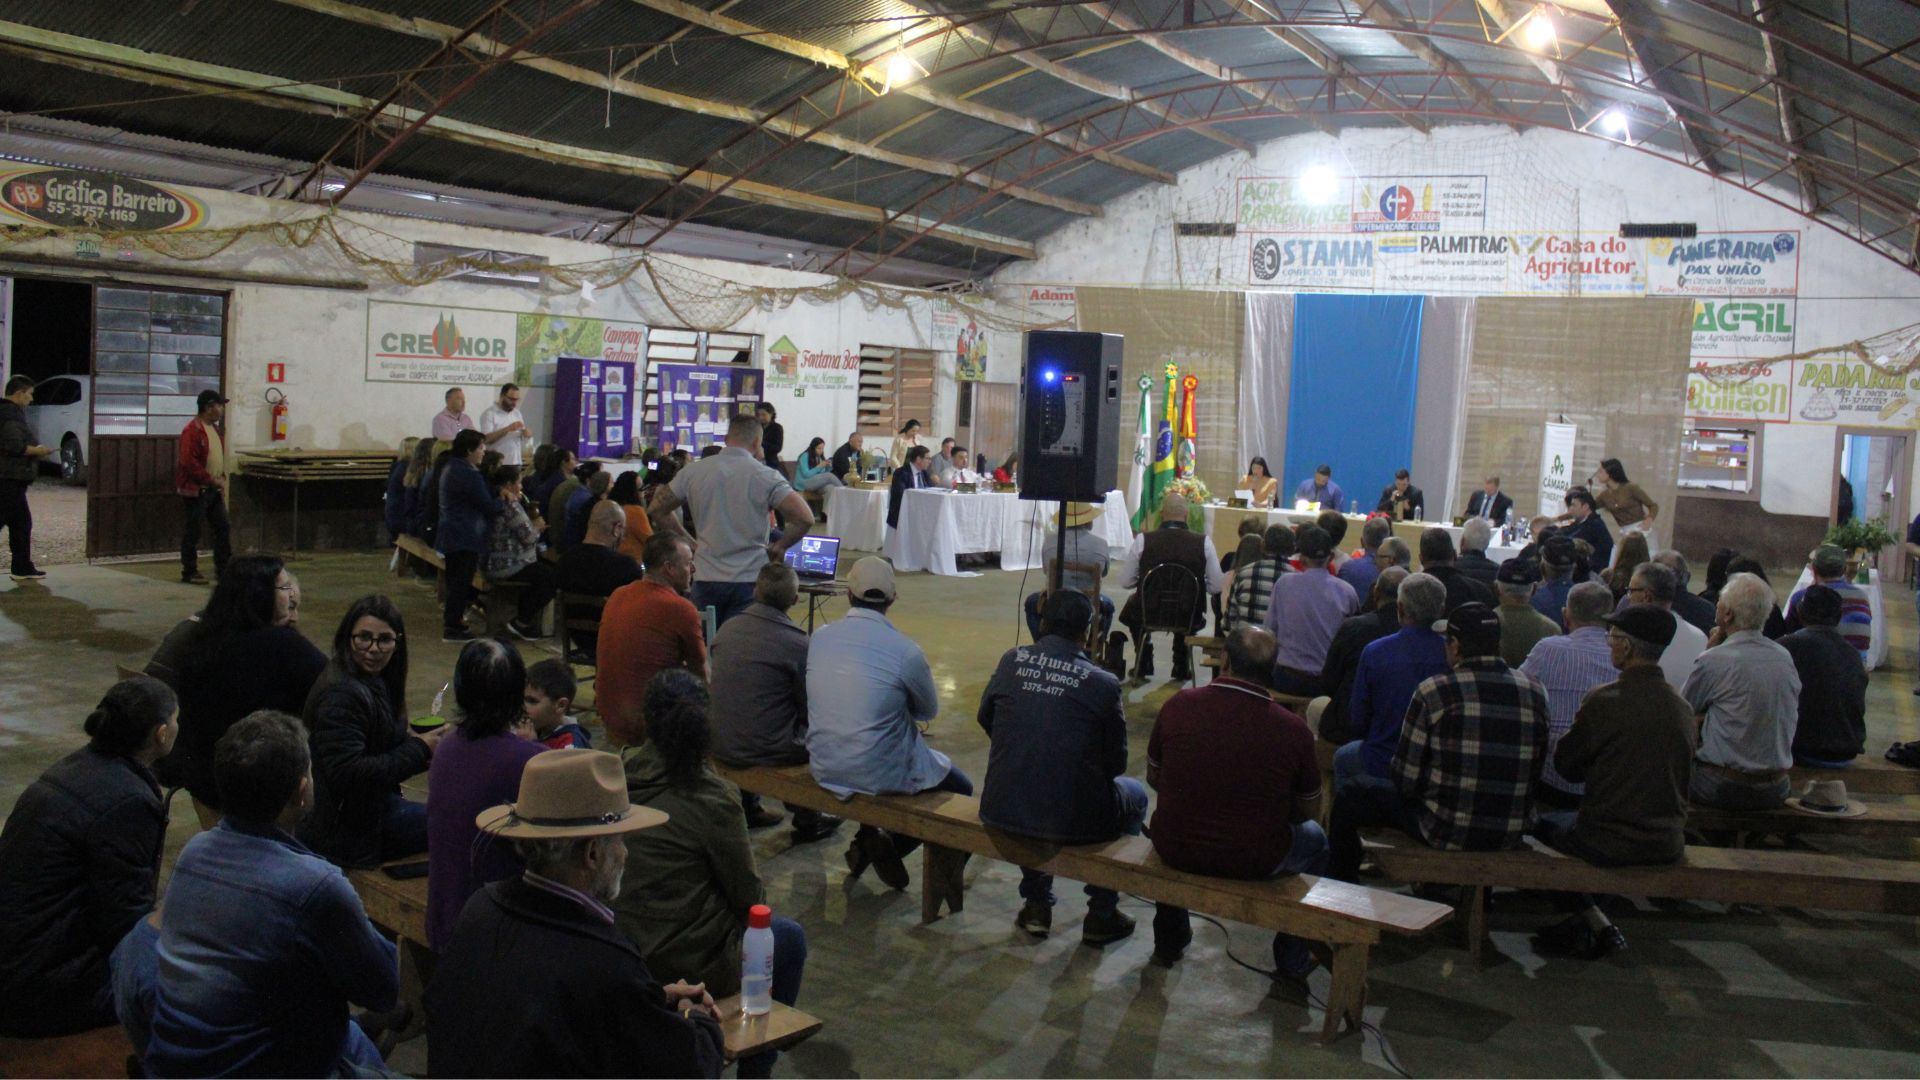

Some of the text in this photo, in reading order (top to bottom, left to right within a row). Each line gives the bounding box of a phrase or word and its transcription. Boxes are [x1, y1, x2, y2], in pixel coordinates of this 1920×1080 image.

[14, 185, 40, 204] GB
[45, 178, 177, 213] Gráfica Barreiro
[47, 201, 138, 222] 55-3757-1169
[1283, 239, 1373, 267] STAMM
[1421, 235, 1508, 254] PALMITRAC
[1545, 235, 1627, 254] Casa do
[1524, 255, 1636, 281] Agricultor
[1685, 261, 1762, 276] PAX UNIÃO
[603, 326, 643, 347] Camping
[801, 349, 841, 370] Fontana
[1798, 362, 1908, 391] PADARIA
[1015, 647, 1091, 680] Schwarz
[1016, 667, 1080, 688] AUTO VIDROS
